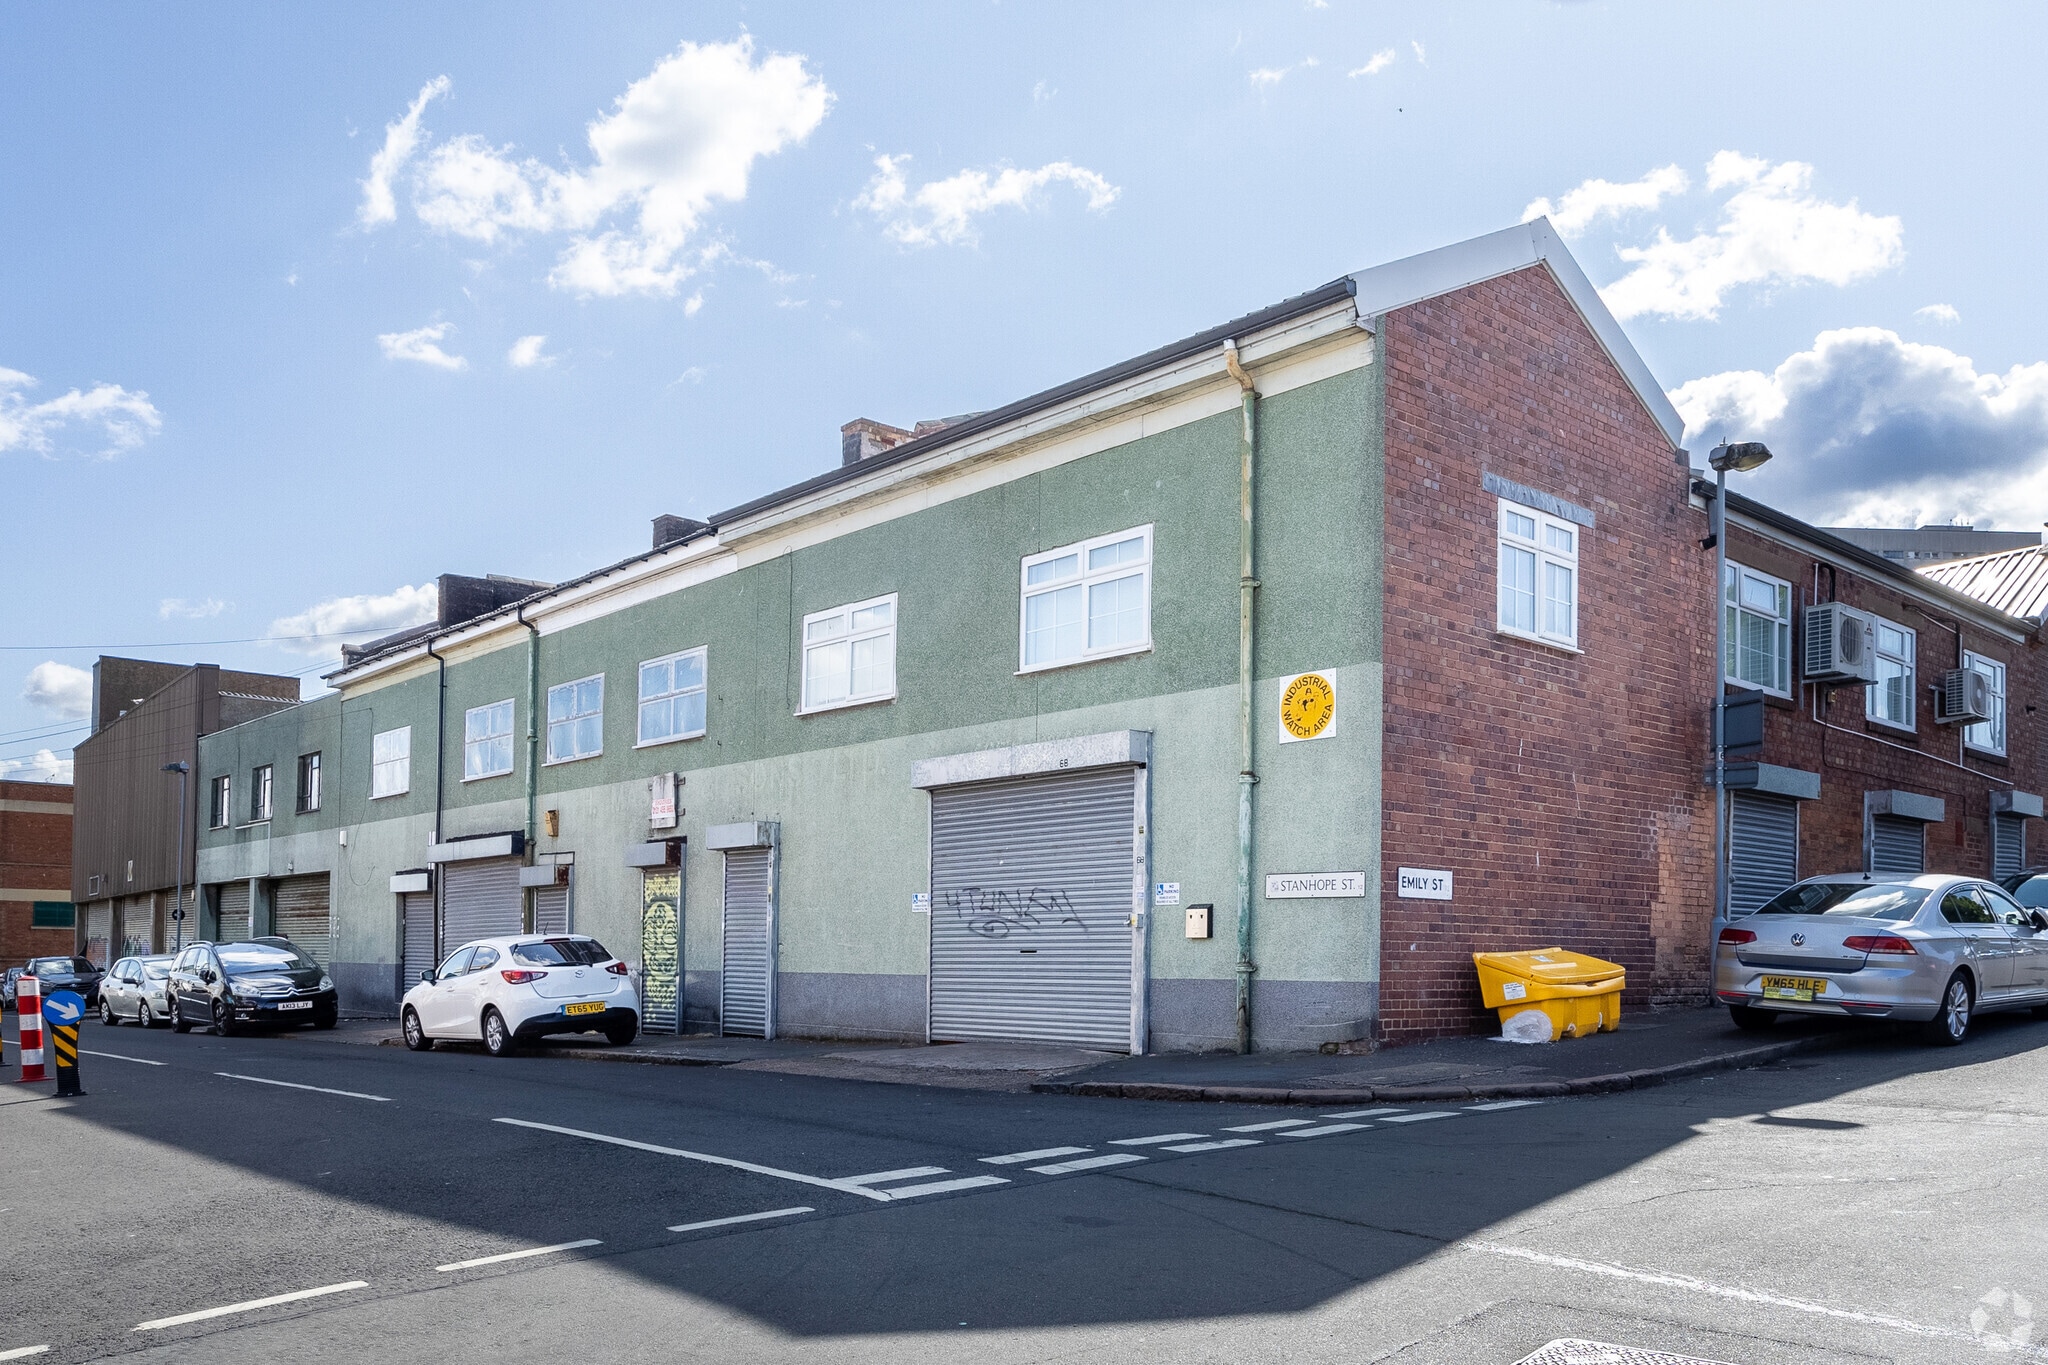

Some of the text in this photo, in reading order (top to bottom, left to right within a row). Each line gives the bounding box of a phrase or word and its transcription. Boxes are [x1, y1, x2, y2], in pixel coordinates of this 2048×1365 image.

[1284, 676, 1331, 706] INDUSTRIAL
[1284, 704, 1332, 736] WATCH AREA
[1280, 879, 1336, 891] STANHOPE
[1341, 878, 1356, 890] ST.
[1402, 876, 1443, 891] EMILY ST
[1767, 977, 1821, 991] YM65 HLE
[566, 1003, 604, 1013] ET65 YUG
